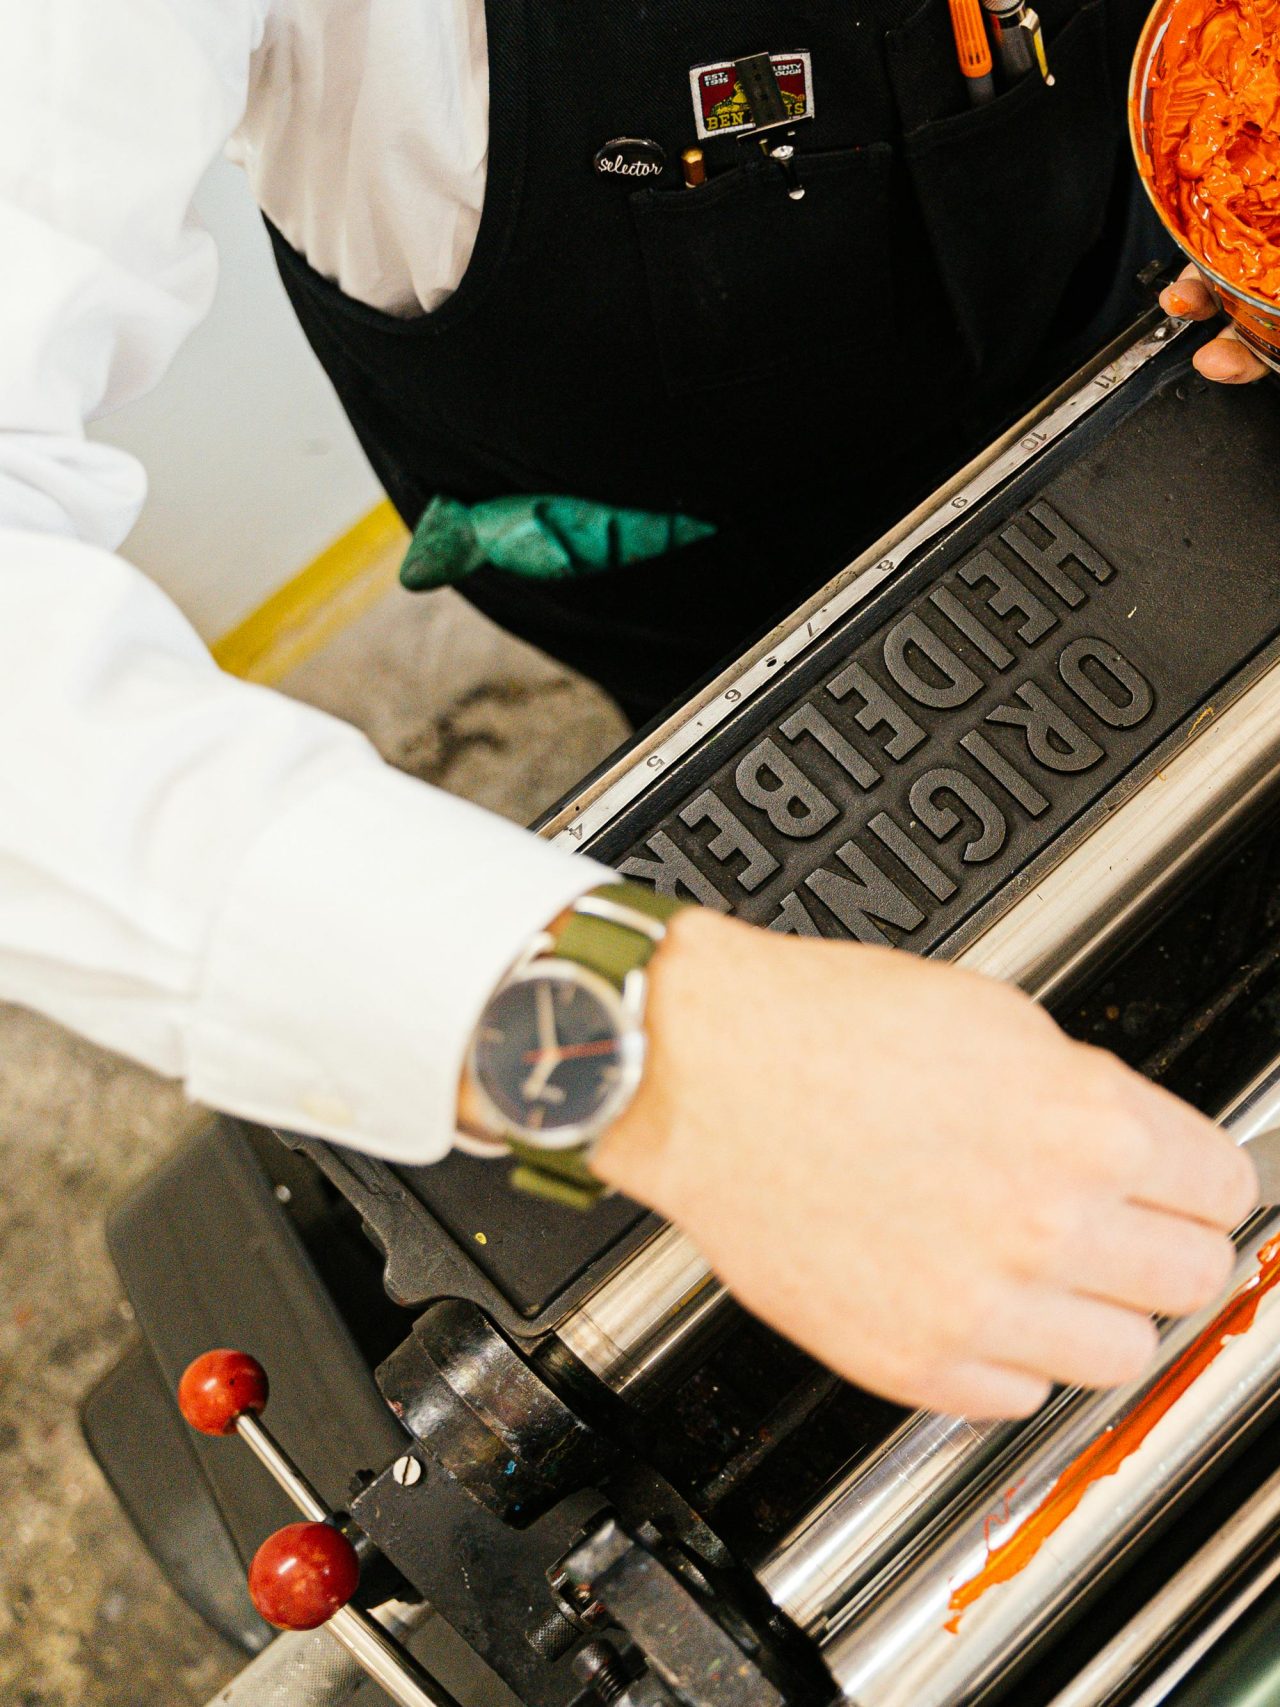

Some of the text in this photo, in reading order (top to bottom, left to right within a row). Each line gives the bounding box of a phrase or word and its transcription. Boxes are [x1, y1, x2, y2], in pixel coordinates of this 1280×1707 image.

[706, 111, 745, 131] BEN
[1020, 431, 1047, 451] 10
[805, 621, 821, 638] 7
[614, 500, 1117, 914] HEIDELBER
[646, 754, 666, 772] 5
[766, 635, 1156, 948] ORIGIN
